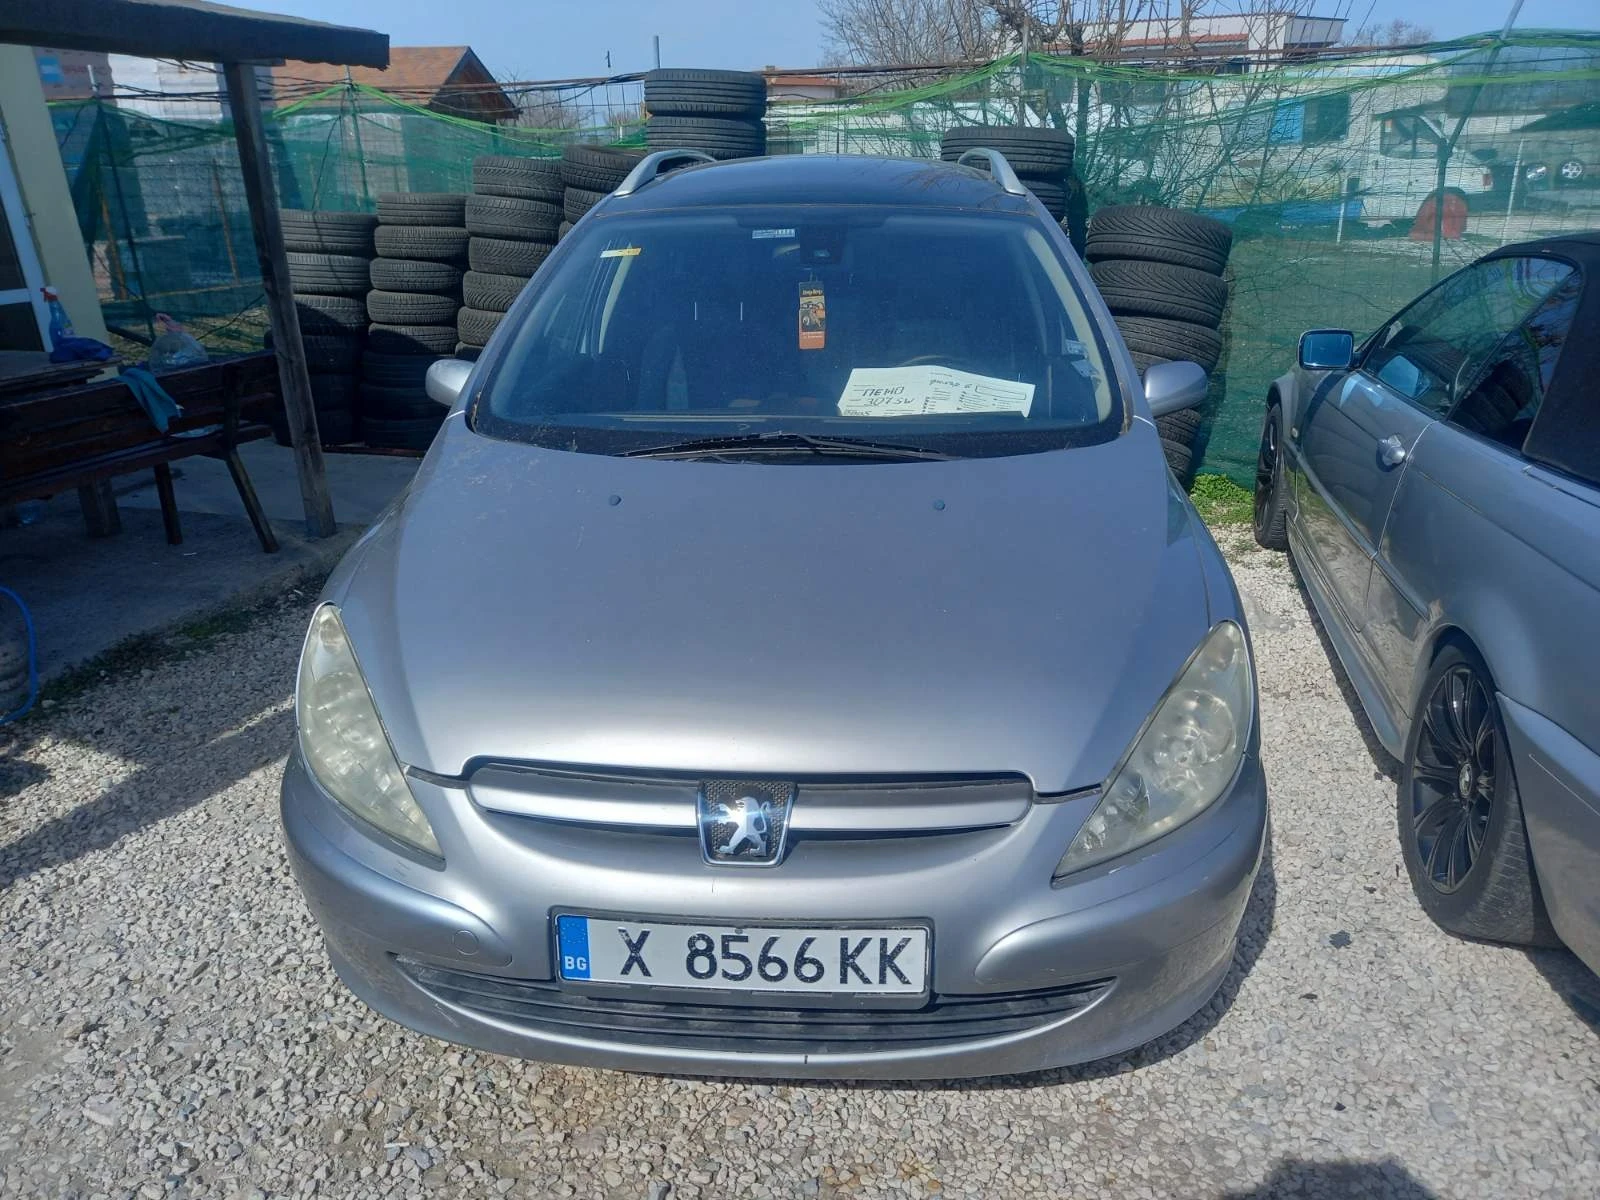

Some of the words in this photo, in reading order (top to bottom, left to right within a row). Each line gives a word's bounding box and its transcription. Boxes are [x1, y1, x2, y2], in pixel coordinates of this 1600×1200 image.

[564, 955, 587, 971] BG
[618, 927, 652, 977] X
[686, 933, 825, 983] 8566
[839, 937, 912, 986] KK
